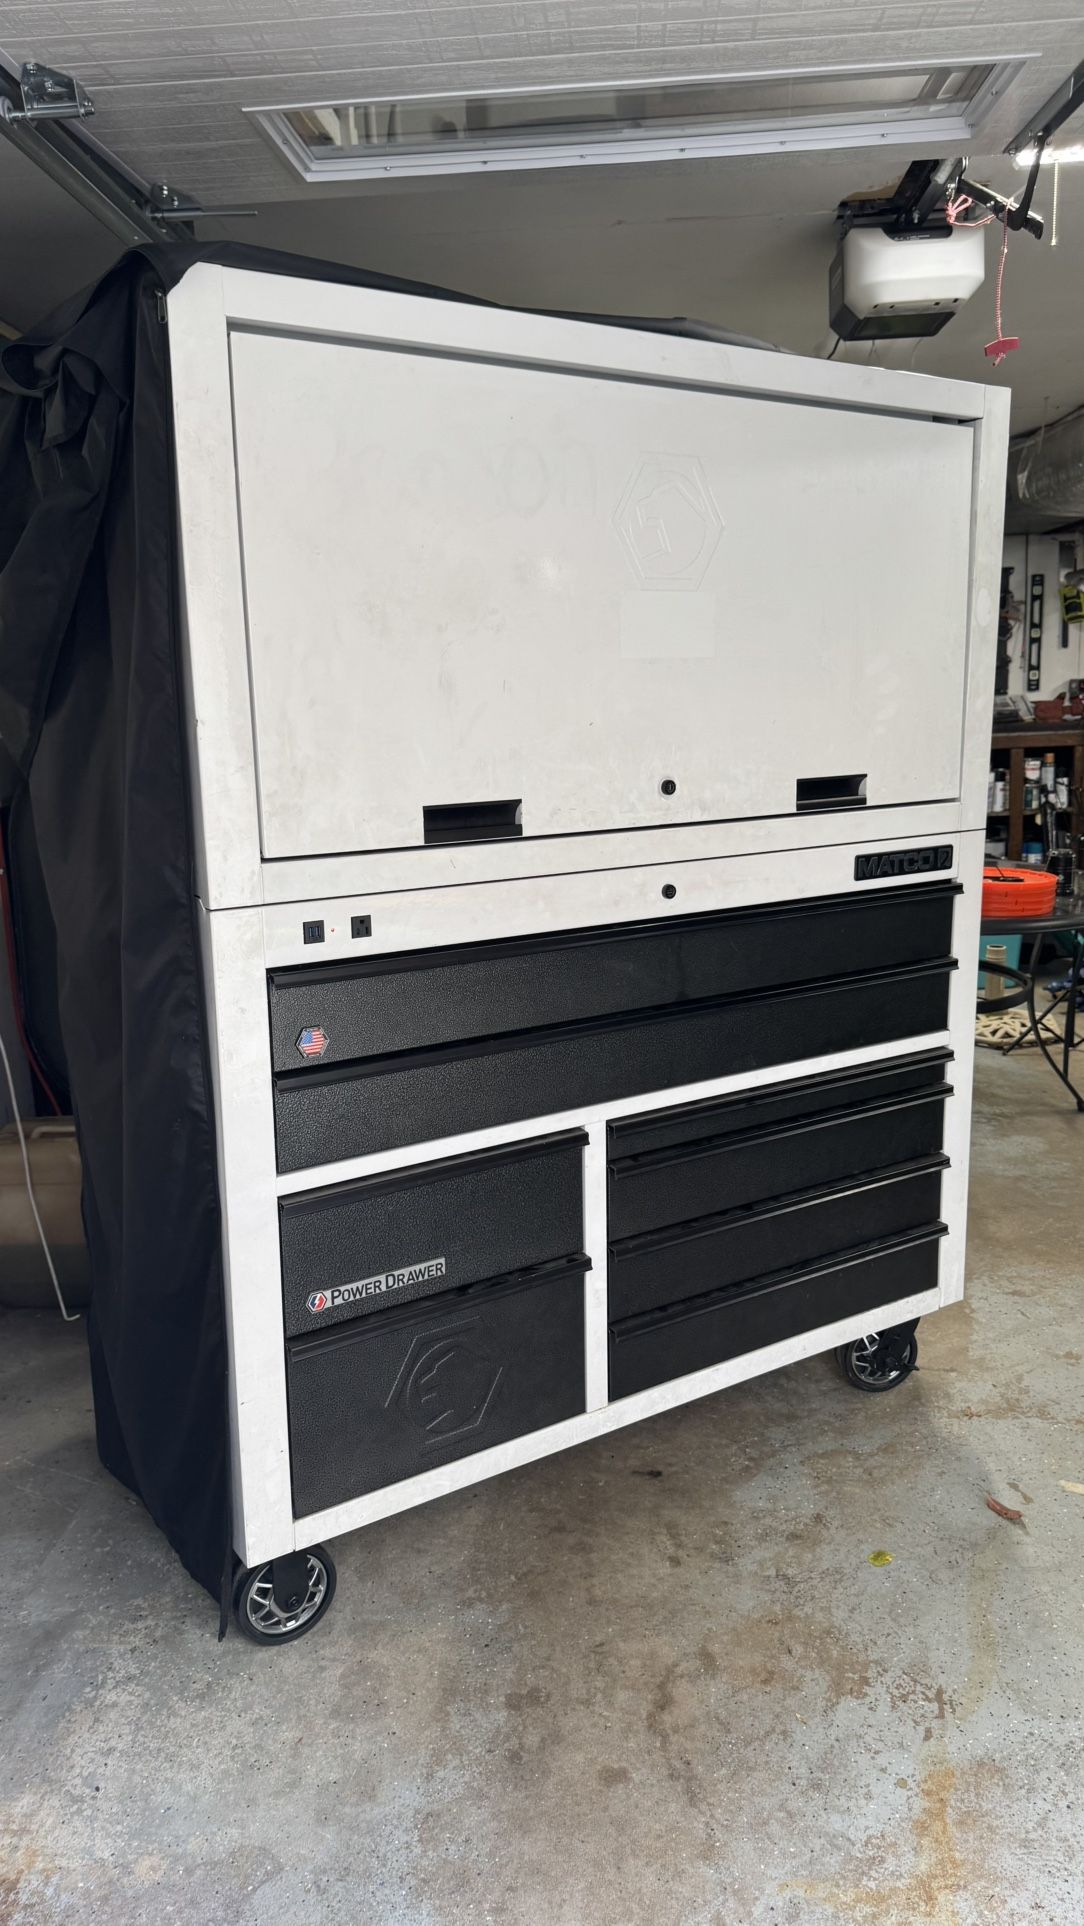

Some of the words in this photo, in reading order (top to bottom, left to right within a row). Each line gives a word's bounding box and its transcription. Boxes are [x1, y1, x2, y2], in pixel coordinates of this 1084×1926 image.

[858, 851, 934, 878] MATCO
[331, 1280, 382, 1305] POWER
[385, 1262, 444, 1289] DRAWER
